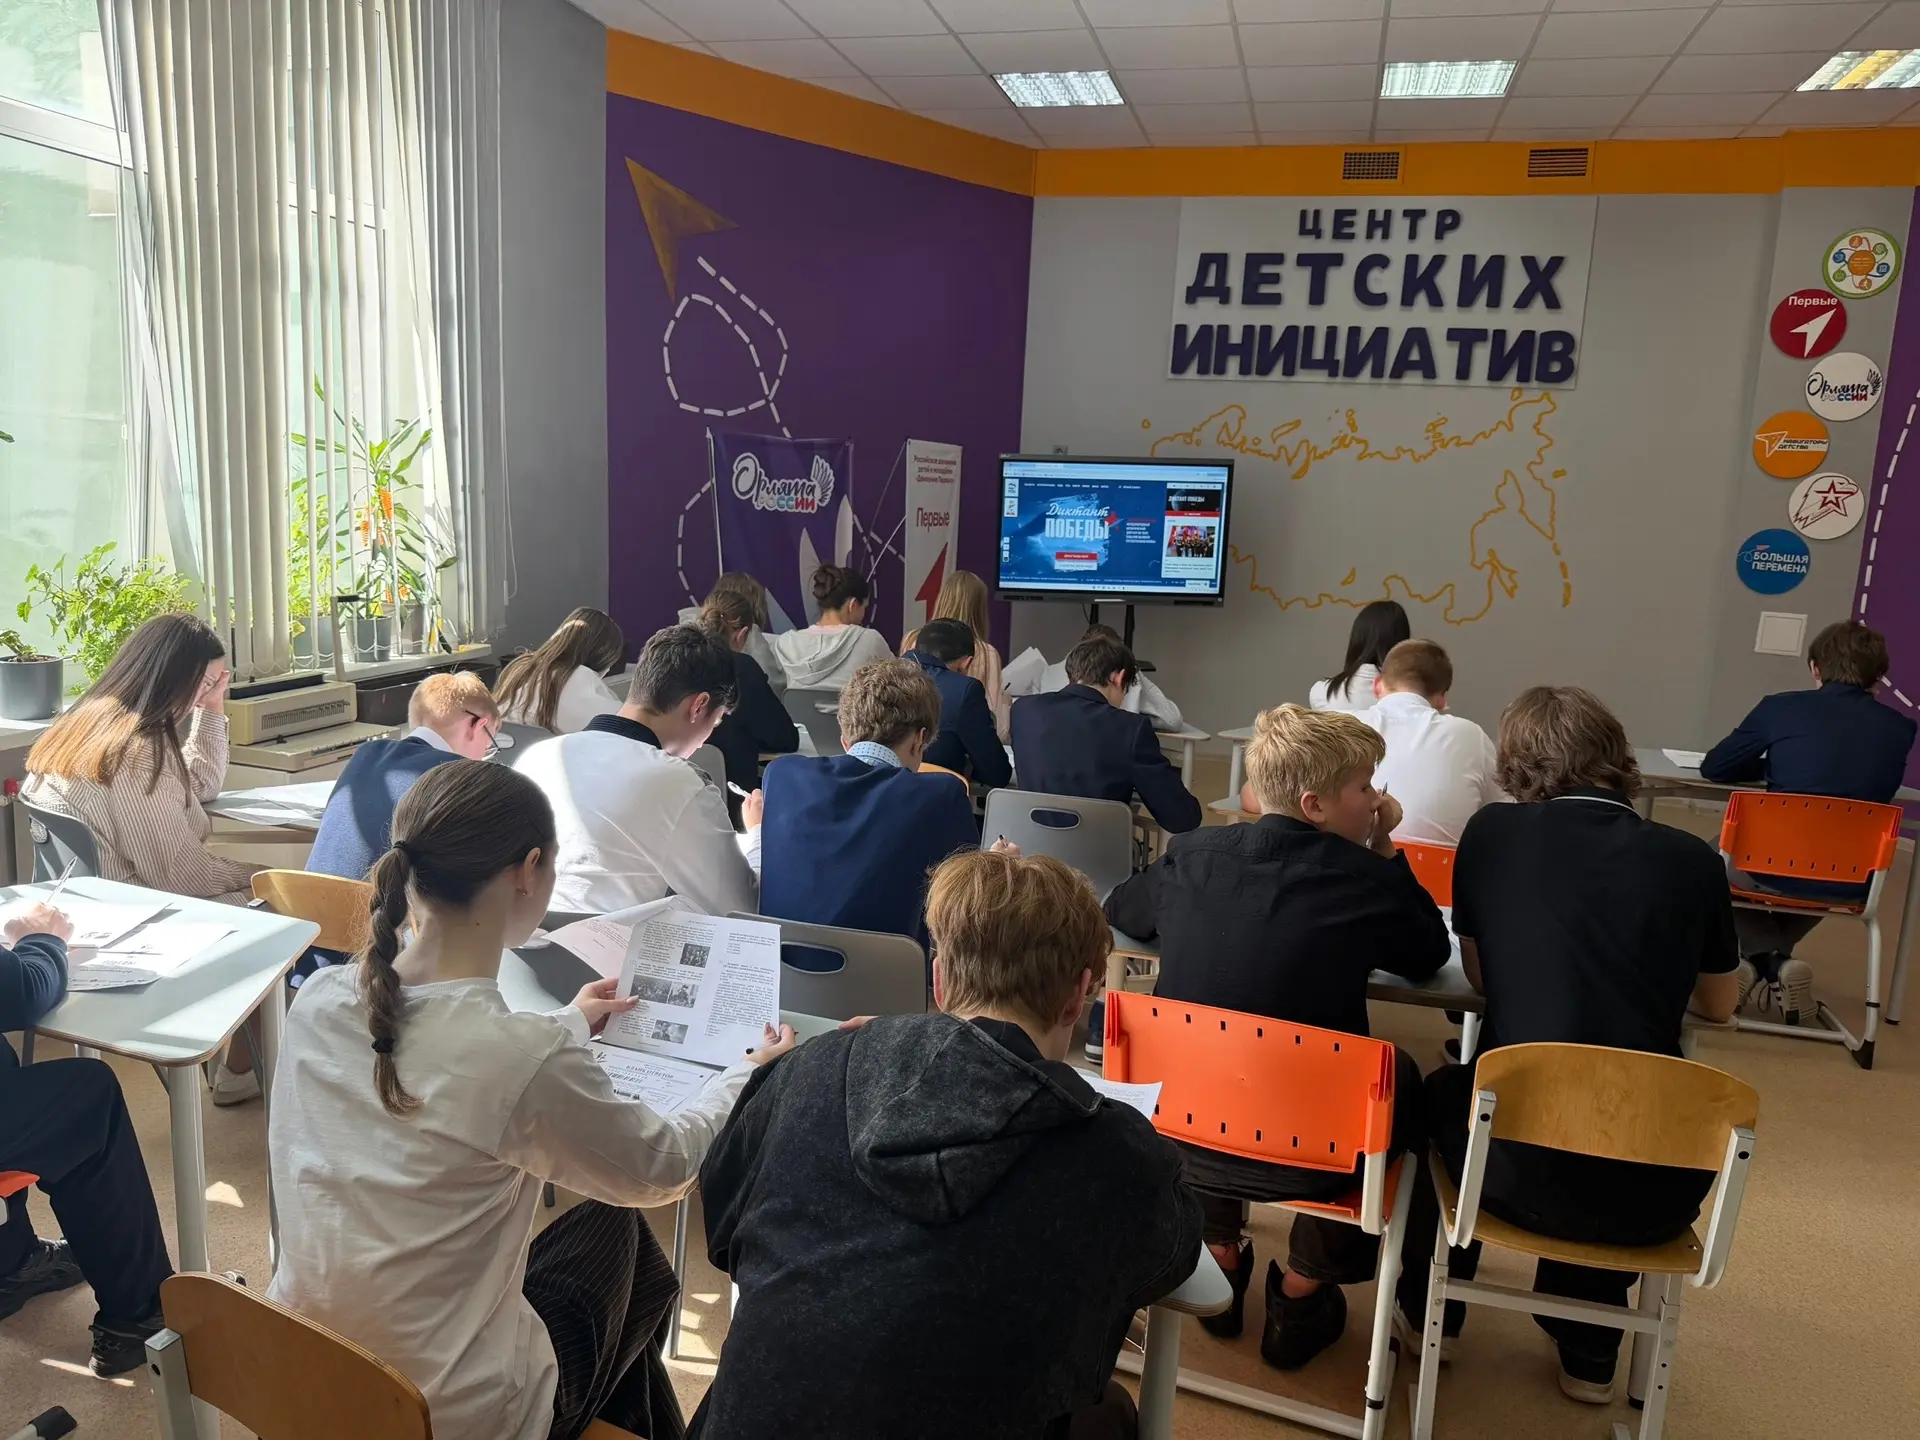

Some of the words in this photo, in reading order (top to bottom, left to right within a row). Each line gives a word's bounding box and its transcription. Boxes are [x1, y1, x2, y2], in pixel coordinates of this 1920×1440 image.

[1298, 208, 1462, 241] ЦЕНТР
[1185, 252, 1566, 310] ДЕТСКИХ
[1788, 295, 1838, 308] Первые
[1170, 324, 1577, 384] ИНИЦИАТИВ
[1807, 371, 1869, 400] Орлята
[1821, 393, 1868, 402] РОССИИ
[734, 455, 817, 503] Орлята
[757, 495, 817, 511] РОССИИ
[1045, 502, 1110, 517] Диктант
[915, 507, 950, 533] Первые
[1044, 517, 1110, 542] ПОБЕДЫ
[1751, 561, 1807, 574] ПЕРЕМЕНА
[1753, 551, 1809, 564] БОЛЬШАЯ
